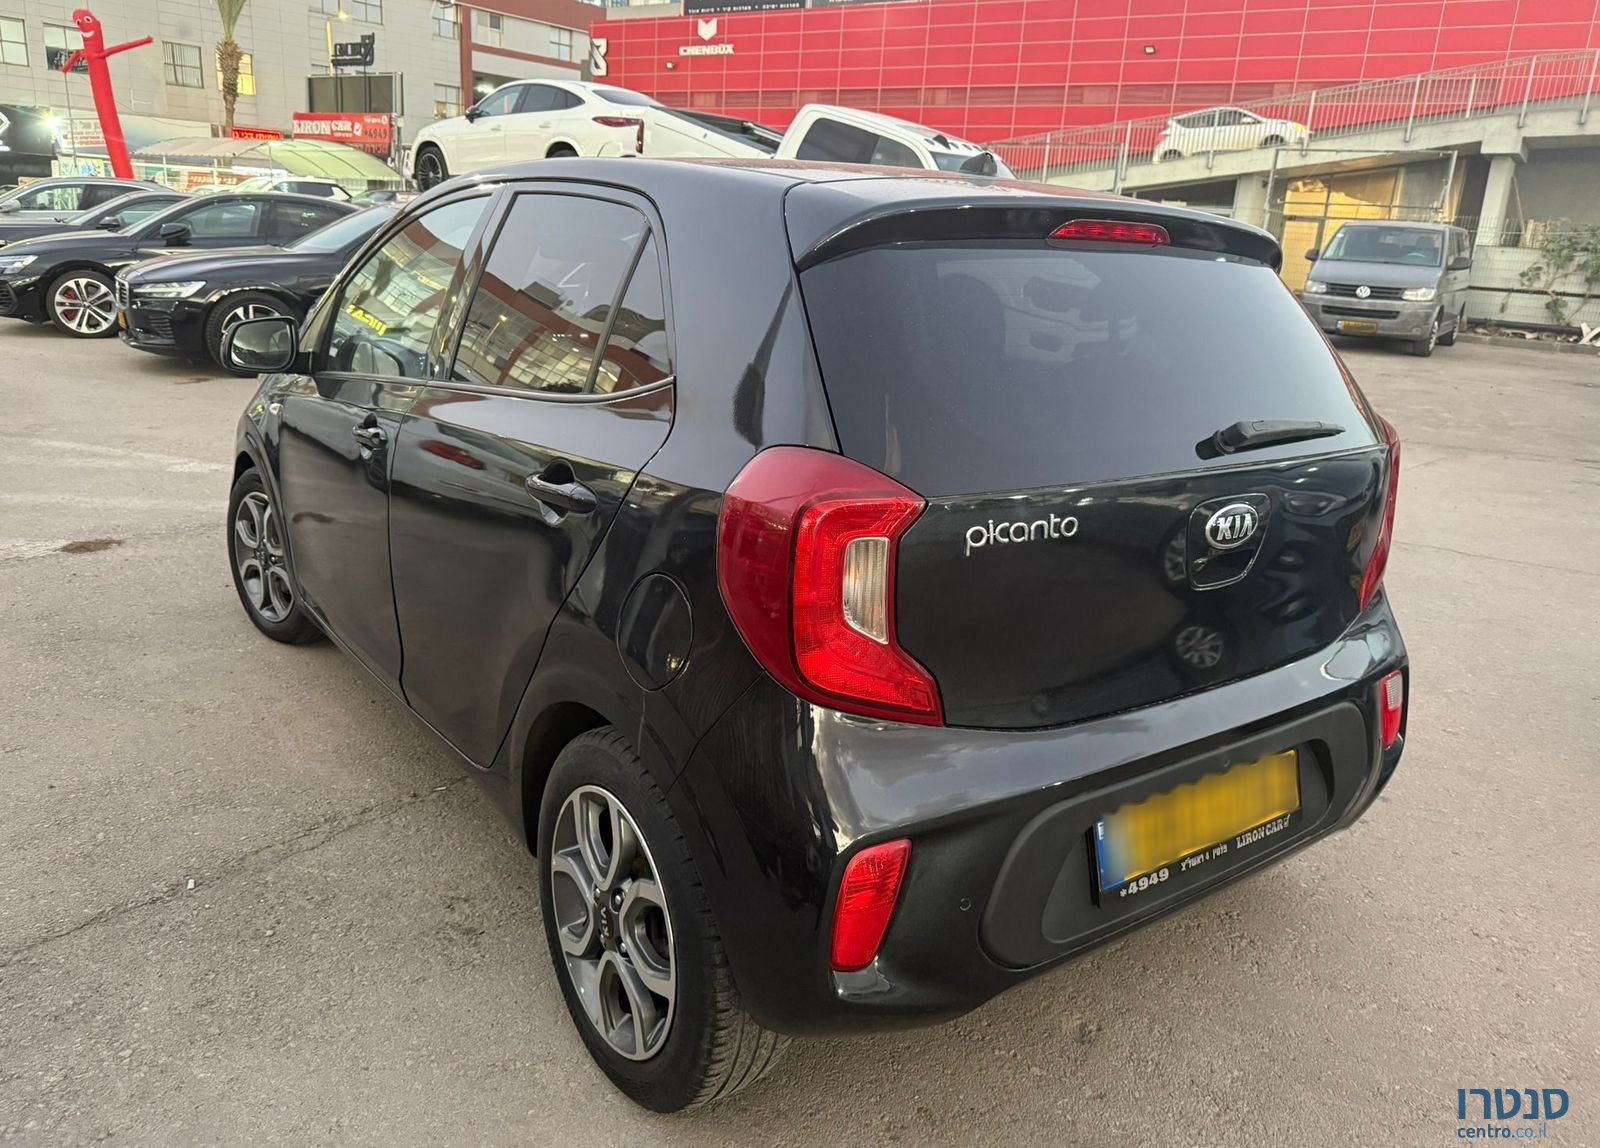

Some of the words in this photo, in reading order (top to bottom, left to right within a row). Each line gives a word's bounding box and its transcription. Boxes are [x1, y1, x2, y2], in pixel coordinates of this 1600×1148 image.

[679, 43, 735, 57] CHENBOX
[292, 119, 332, 135] LIRON
[332, 120, 353, 132] CAR
[965, 513, 1079, 557] picanto
[1216, 513, 1254, 542] KIA
[1235, 826, 1265, 849] LIRON
[1265, 818, 1284, 837] CAR
